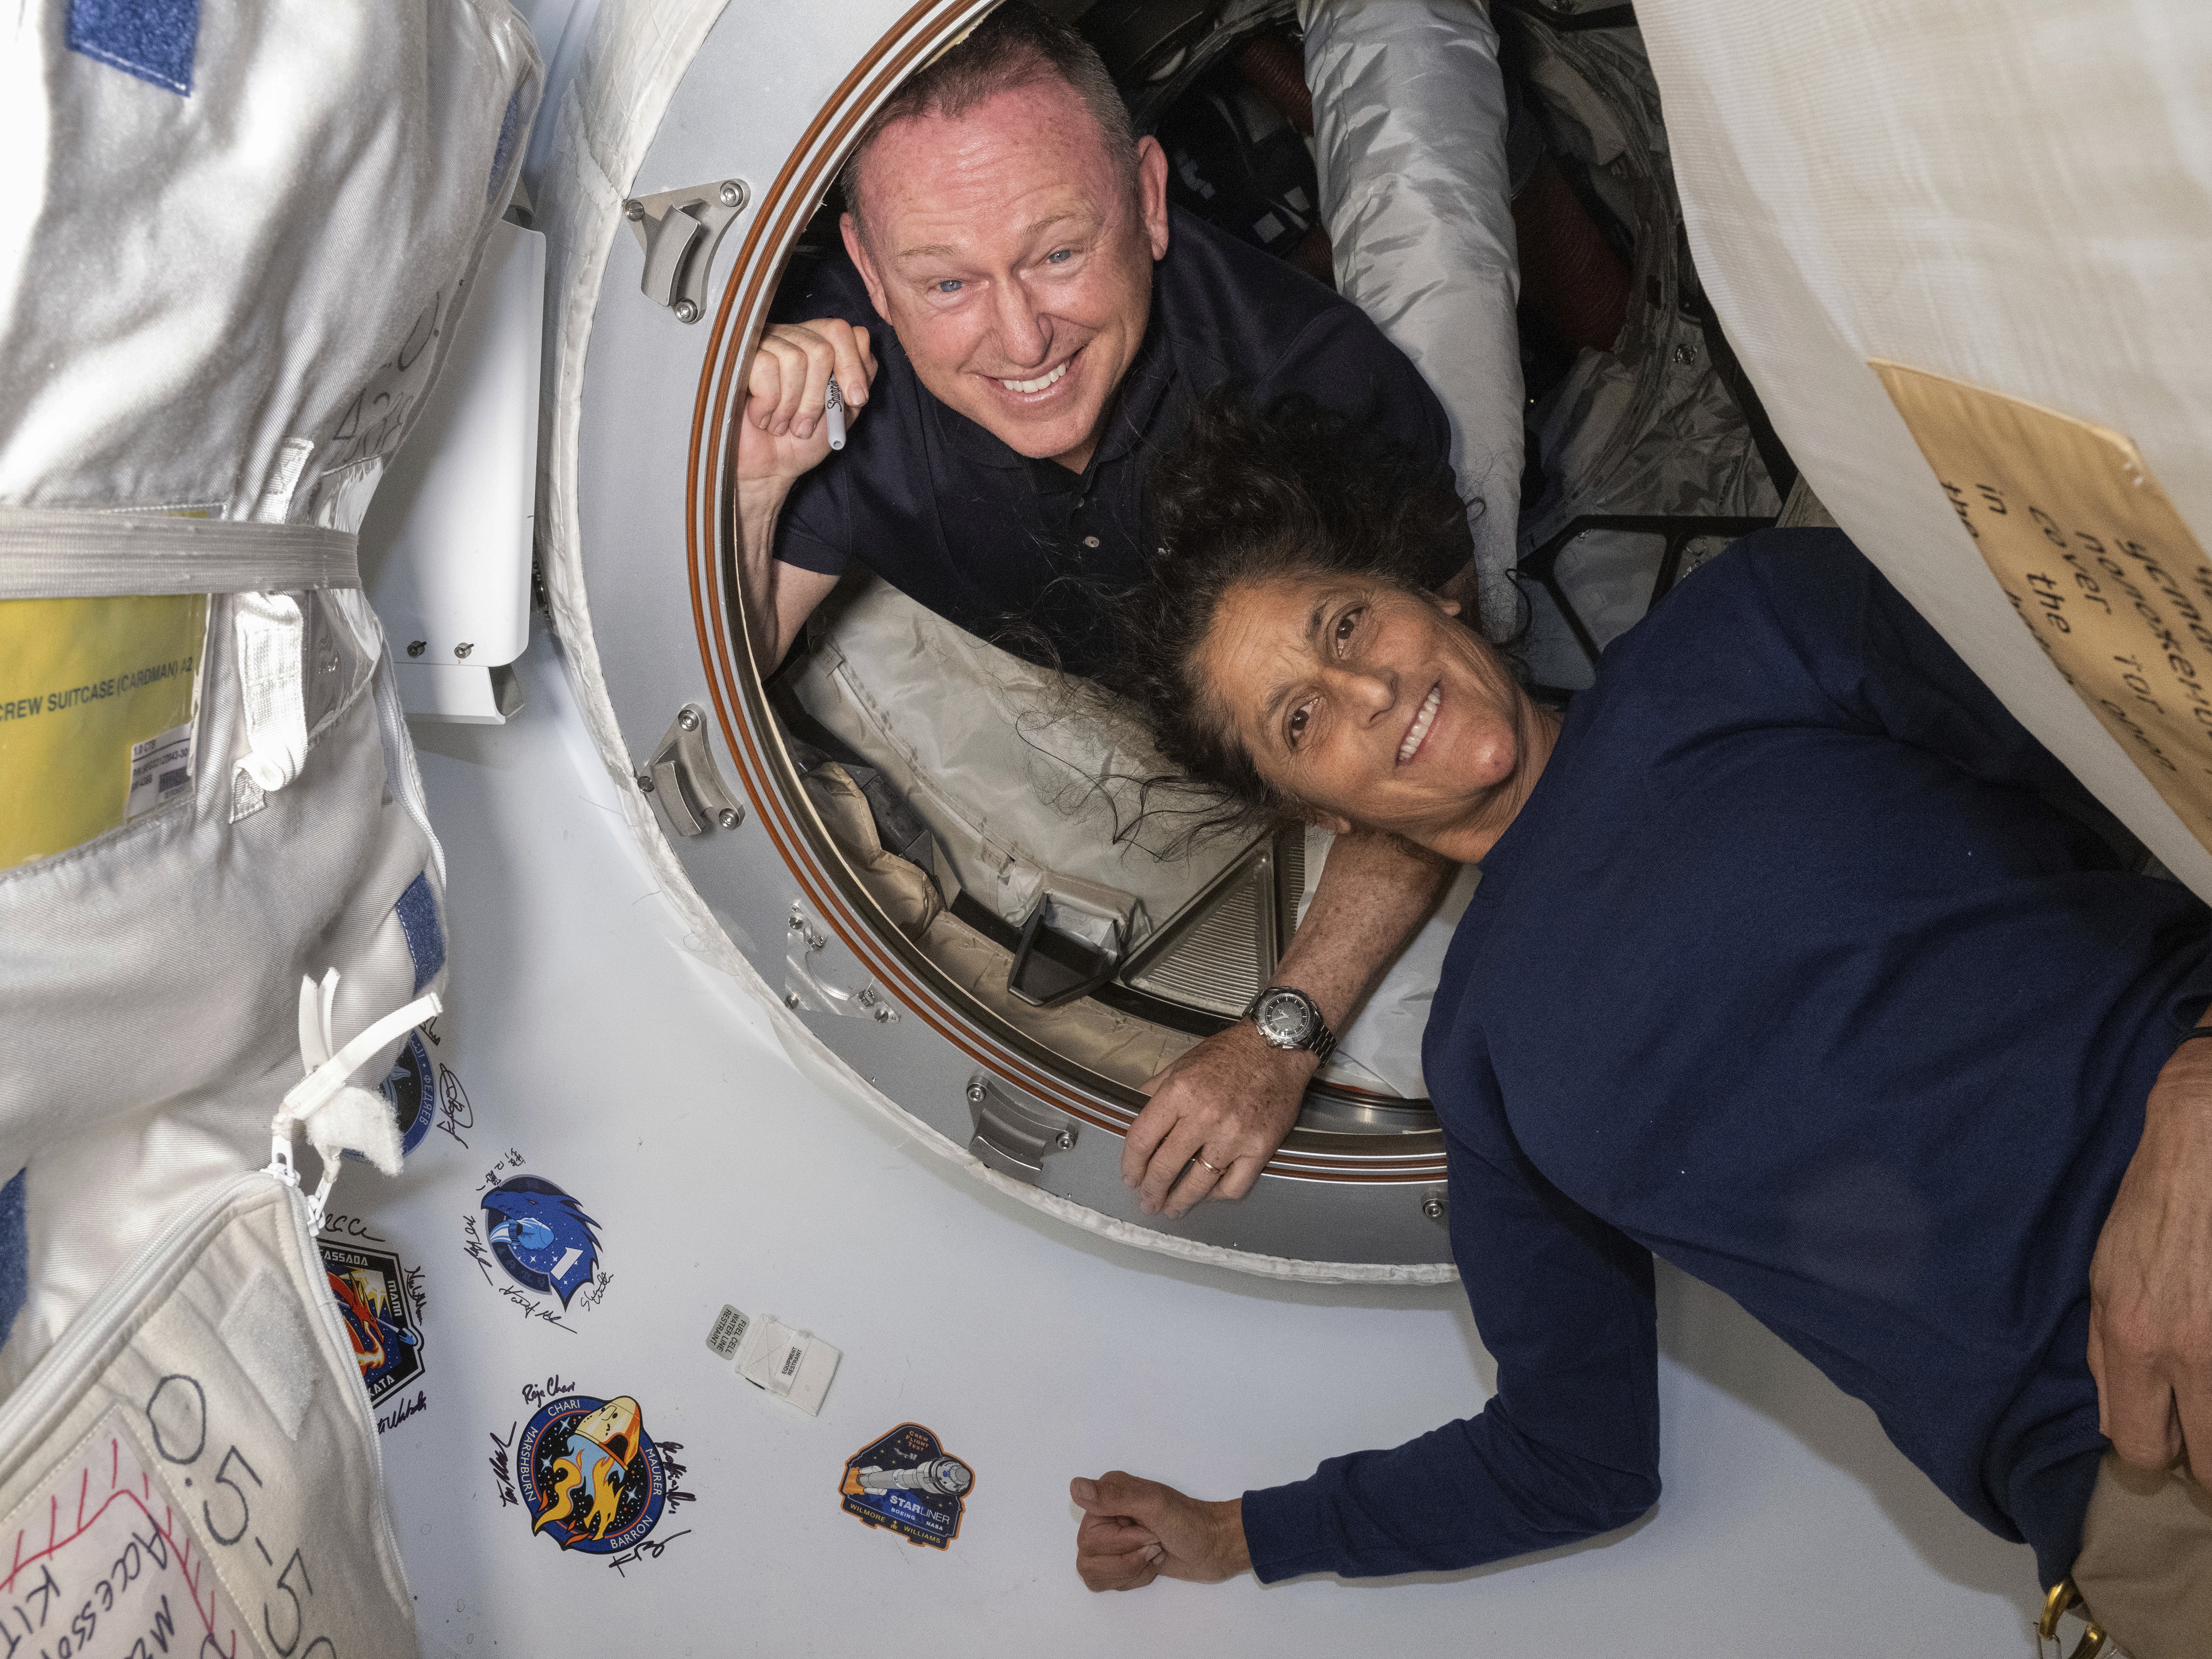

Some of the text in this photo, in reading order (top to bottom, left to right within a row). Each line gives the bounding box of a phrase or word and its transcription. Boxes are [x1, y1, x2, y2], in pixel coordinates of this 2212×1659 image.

[1976, 484, 2008, 515] in
[2026, 572, 2071, 633] the
[2028, 506, 2113, 615] cover
[47, 679, 114, 712] SUITCASE
[419, 1074, 433, 1126] ФЕДЯЕВ
[710, 1309, 732, 1346] RESTRAINT
[717, 1313, 740, 1352] WATER LINE
[725, 1319, 747, 1354] FUEL CELL
[781, 1347, 797, 1374] EQUIPMENT
[787, 1349, 802, 1376] RESTRAINT
[548, 1399, 581, 1417] CHARI
[905, 1435, 929, 1447] FLIGHT
[908, 1442, 925, 1452] TEST
[909, 1430, 929, 1442] CREW
[519, 1426, 539, 1502] MARSHBURN
[645, 1448, 662, 1496] MAURER
[850, 1503, 941, 1544] WILMORE WILLIAMS
[889, 1495, 951, 1525] STARLINER
[891, 1508, 943, 1531] BOEING NASA
[610, 1515, 654, 1549] BARRON
